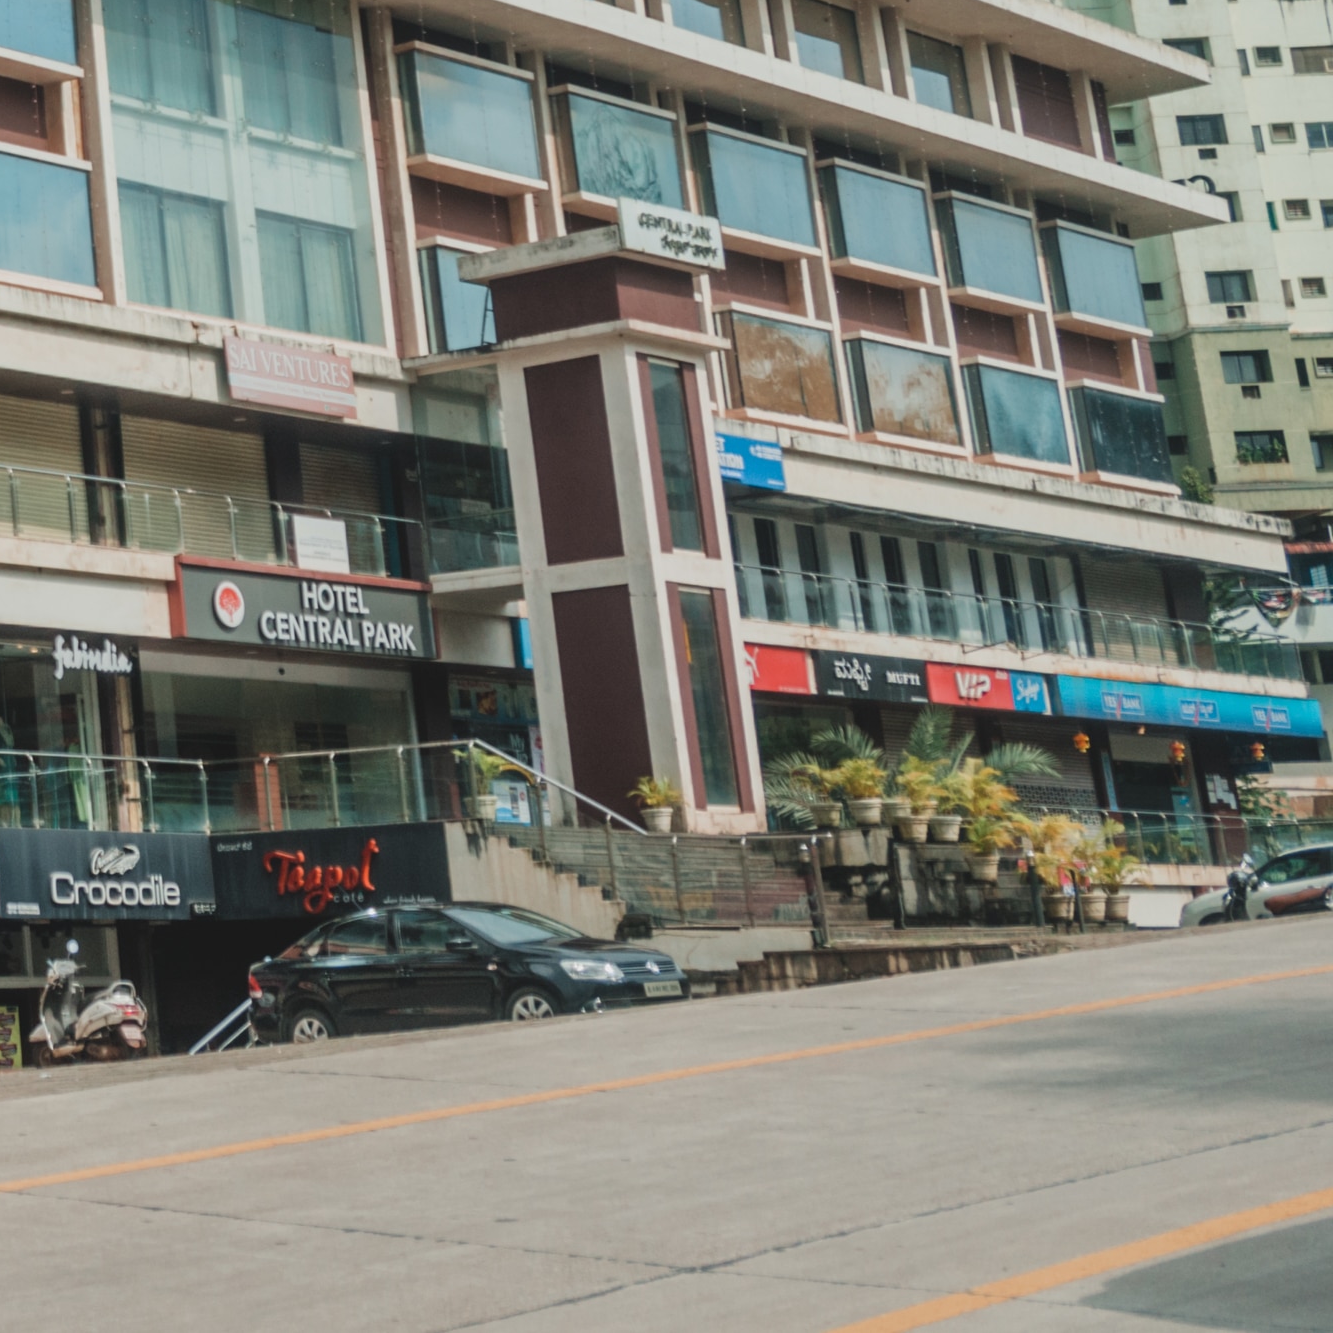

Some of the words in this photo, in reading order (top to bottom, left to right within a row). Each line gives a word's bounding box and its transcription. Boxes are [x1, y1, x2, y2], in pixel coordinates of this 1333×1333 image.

[228, 343, 257, 372] SAI
[259, 348, 351, 388] VENTURES
[301, 581, 370, 615] HOTEL
[259, 610, 361, 647] CENTRAL
[362, 621, 417, 651] PARK
[53, 633, 133, 680] fabindia
[885, 670, 922, 686] MUFTI
[955, 671, 992, 700] VIP
[1103, 695, 1117, 708] YES
[1122, 697, 1141, 710] BANK
[50, 871, 181, 906] Crocodile
